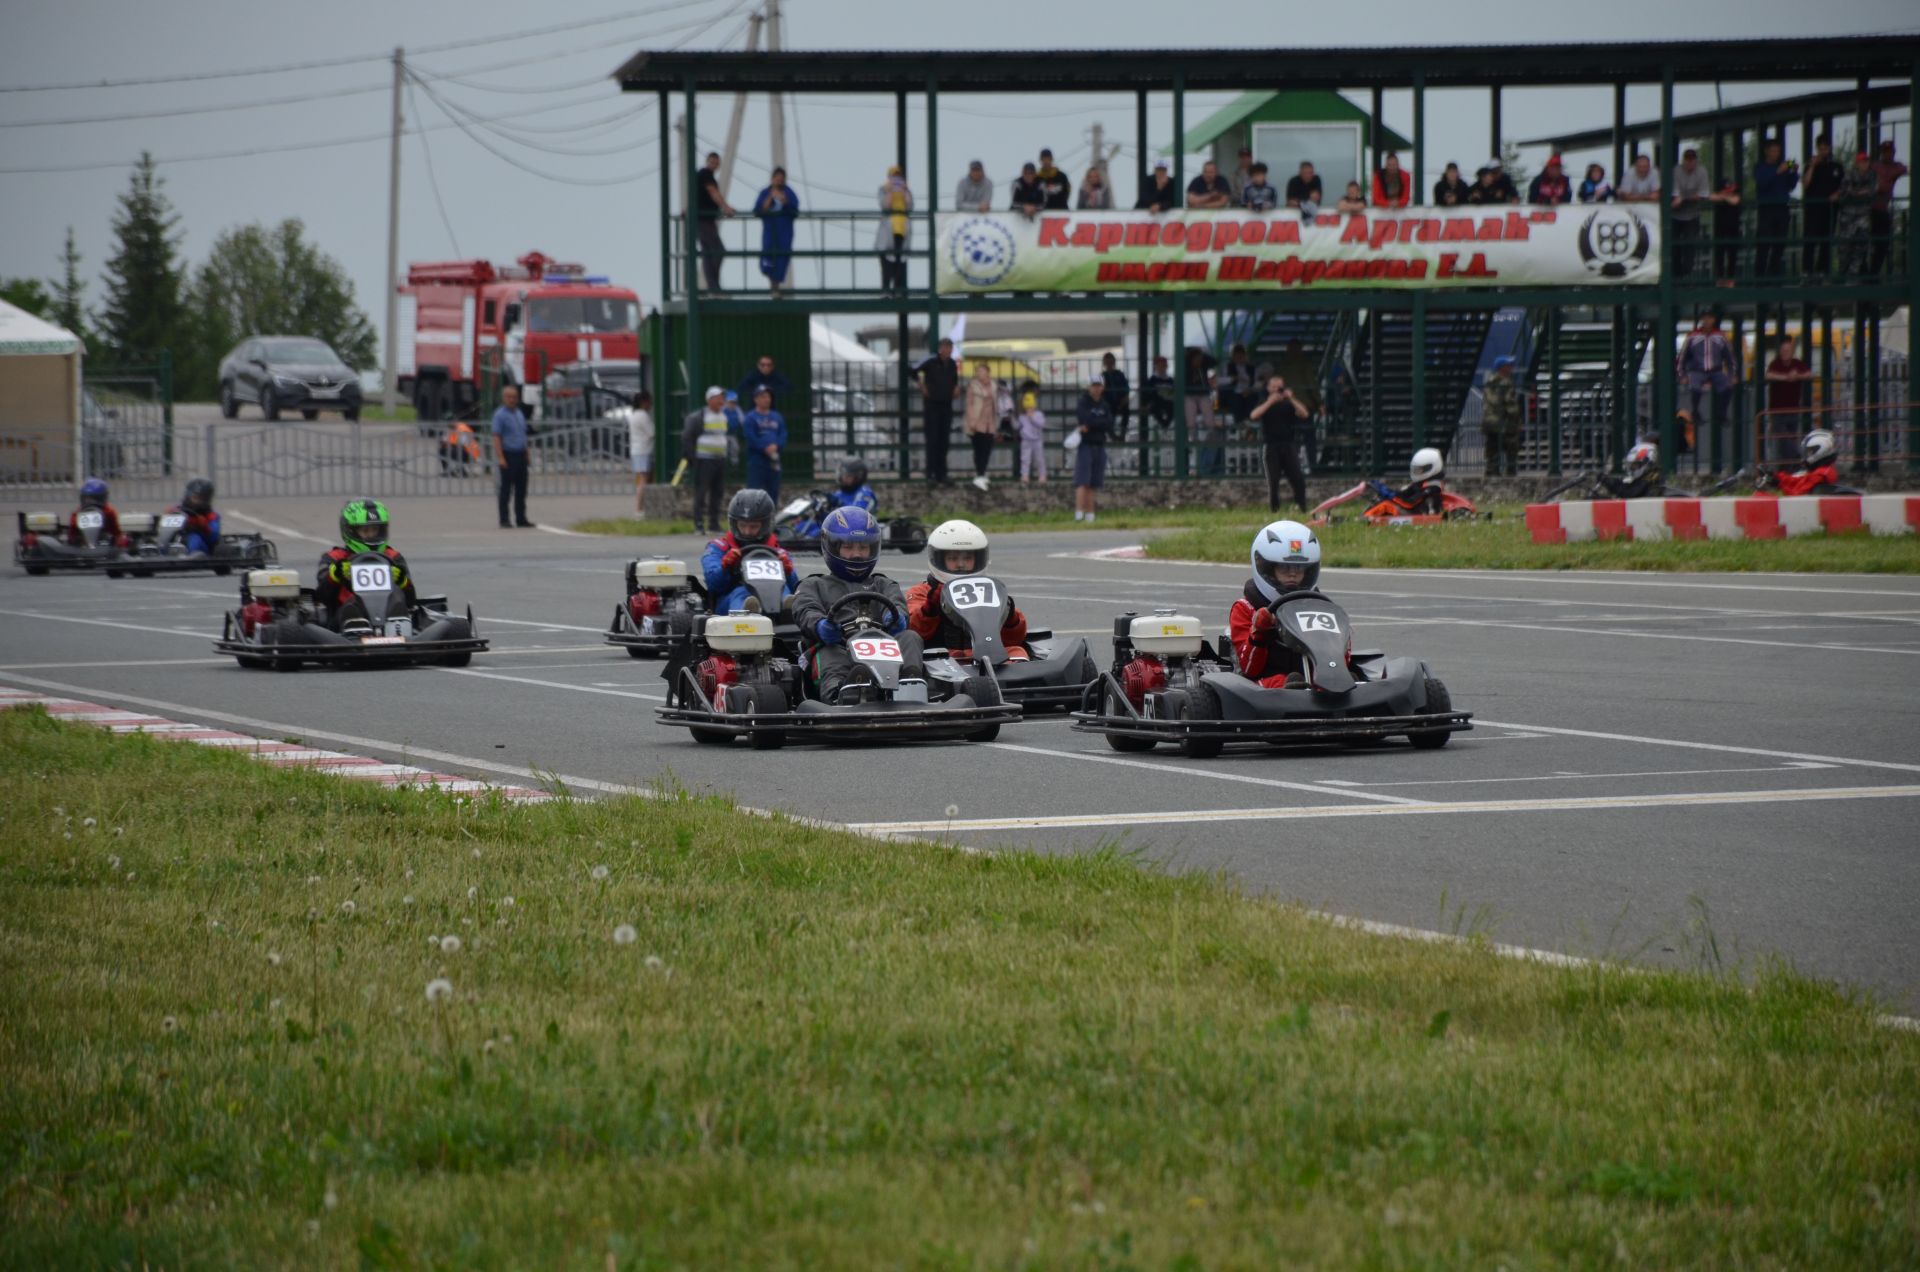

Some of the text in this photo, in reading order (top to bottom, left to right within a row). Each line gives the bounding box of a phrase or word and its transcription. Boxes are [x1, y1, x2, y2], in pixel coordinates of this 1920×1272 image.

[1038, 217, 1301, 254] Картодром
[749, 561, 780, 575] 58
[356, 568, 387, 587] 60
[952, 582, 994, 606] 37
[1298, 613, 1336, 630] 79
[853, 641, 901, 658] 95
